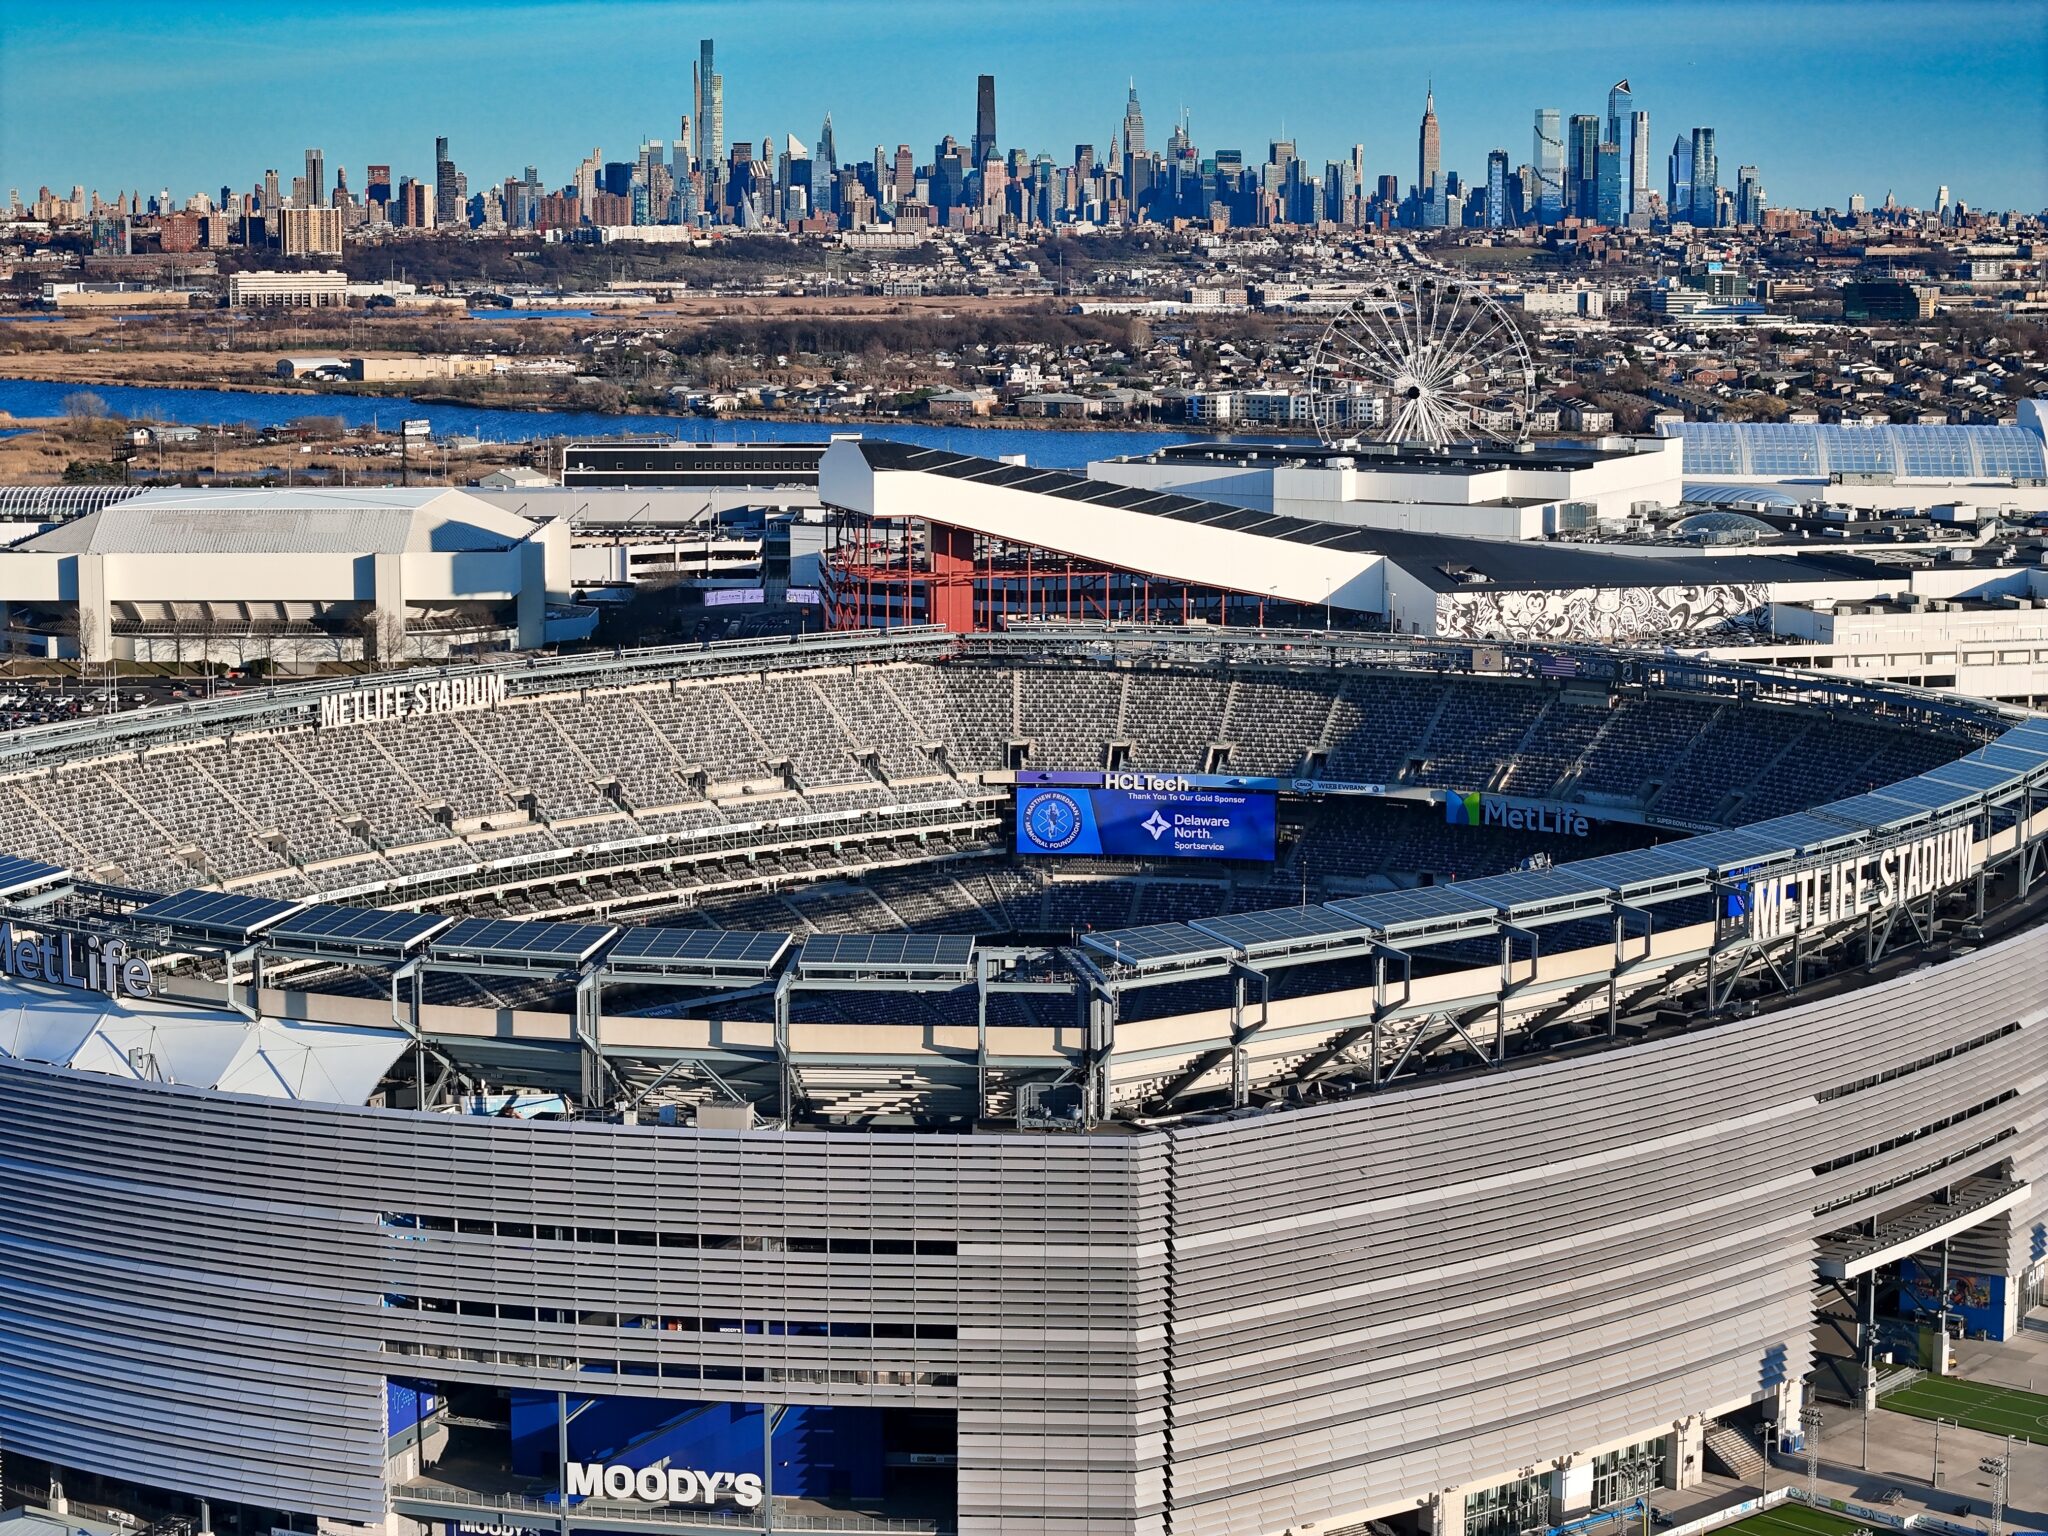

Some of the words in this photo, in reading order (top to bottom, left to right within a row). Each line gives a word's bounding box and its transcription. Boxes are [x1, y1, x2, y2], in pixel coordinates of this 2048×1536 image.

[321, 686, 408, 727] METLIFE
[414, 674, 505, 714] STADIUM
[1105, 774, 1189, 791] HCLTech
[1317, 781, 1338, 790] WEEB
[1338, 782, 1367, 792] EWBANK
[1026, 793, 1052, 816] MATTHEW
[1052, 793, 1080, 816] FRIEDMAN
[1153, 793, 1167, 801] You
[1195, 794, 1213, 802] Gold
[1214, 795, 1246, 804] Sponsor
[794, 816, 805, 824] 93
[806, 814, 827, 822] MARTY
[828, 812, 846, 820] LYONS
[1174, 814, 1230, 827] Delaware
[1484, 800, 1589, 837] MetLife
[1025, 821, 1048, 848] MEMORIAL
[1049, 821, 1081, 849] FOUNDATION
[1174, 827, 1210, 839] North
[592, 844, 600, 852] 75
[1174, 841, 1225, 851] Sportservice
[527, 853, 541, 862] LEON
[541, 851, 556, 860] HESS
[407, 875, 418, 883] 60
[418, 871, 438, 882] LARRY
[1753, 856, 1870, 941] METLIFE
[1878, 823, 1974, 908] STADIUM
[318, 892, 329, 901] 99
[329, 890, 345, 899] MARK
[566, 1462, 762, 1507] MOODY'S
